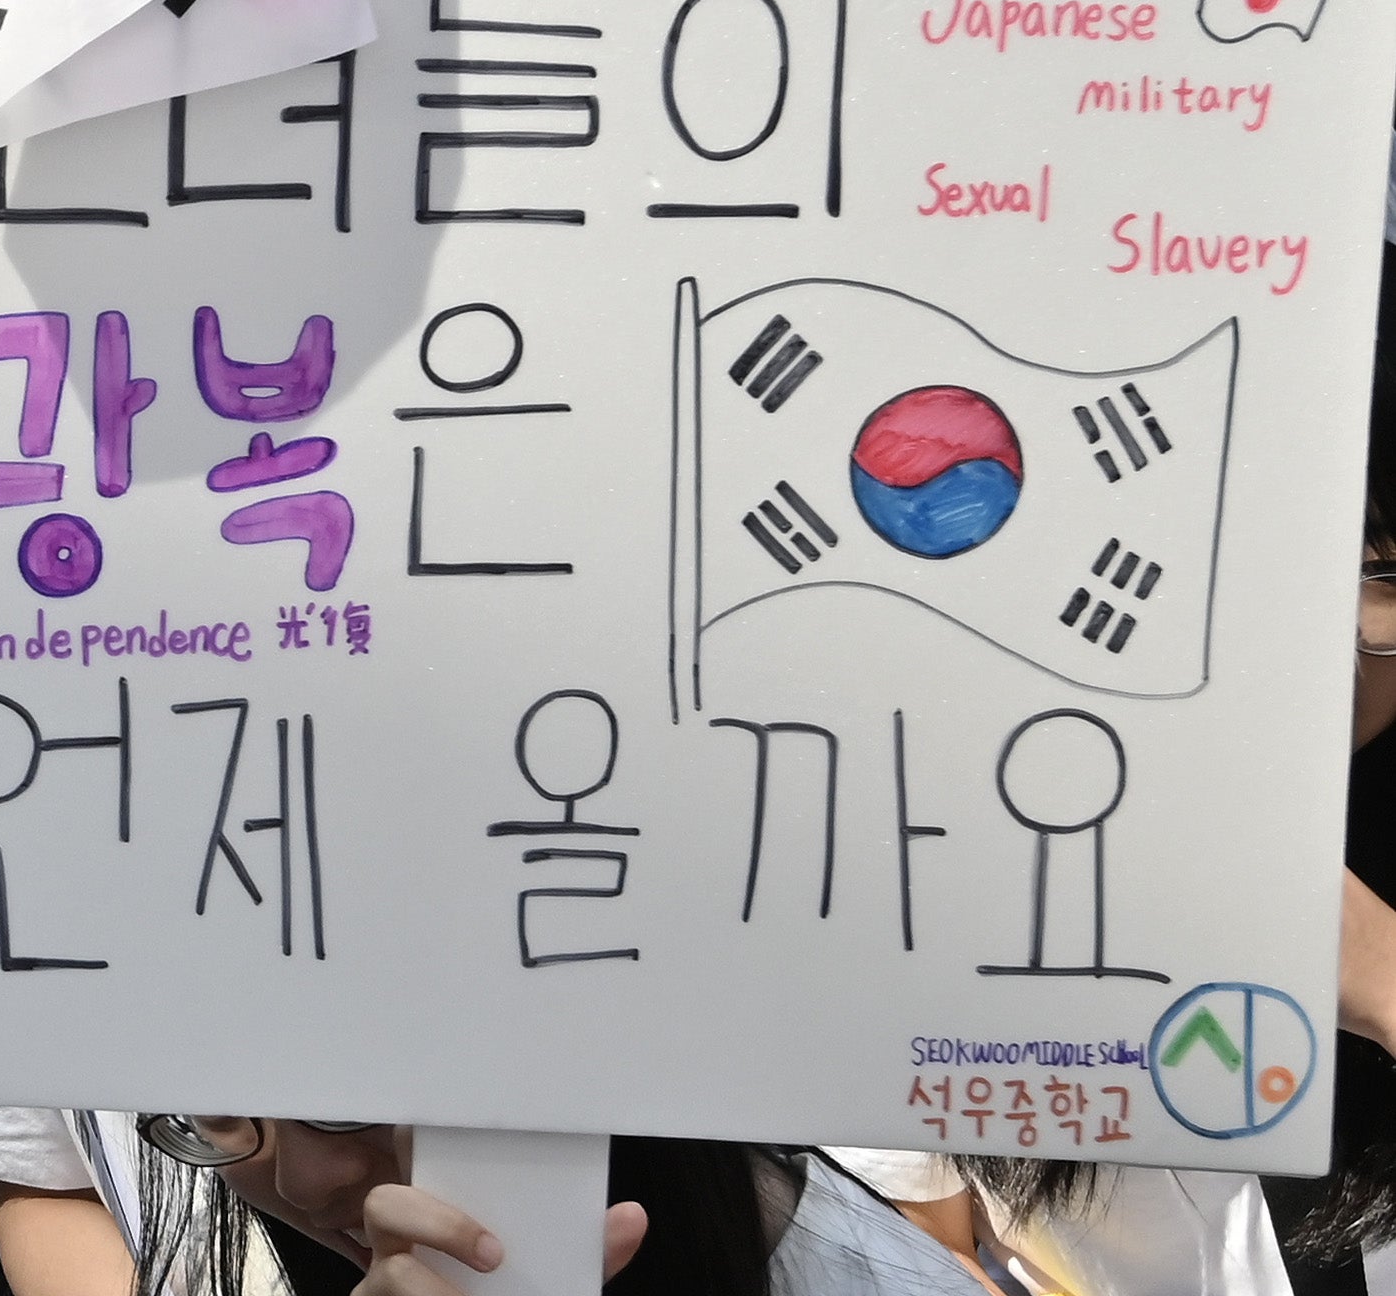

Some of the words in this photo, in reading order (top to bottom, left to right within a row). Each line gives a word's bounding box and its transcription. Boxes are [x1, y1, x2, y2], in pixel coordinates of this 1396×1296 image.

[1075, 74, 1273, 132] military
[917, 162, 1050, 223] Sexual
[1107, 211, 1309, 295] Slavery
[277, 603, 374, 655] 光復
[487, 688, 1171, 986] 올까요
[908, 1074, 1131, 1148] 석우중학교
